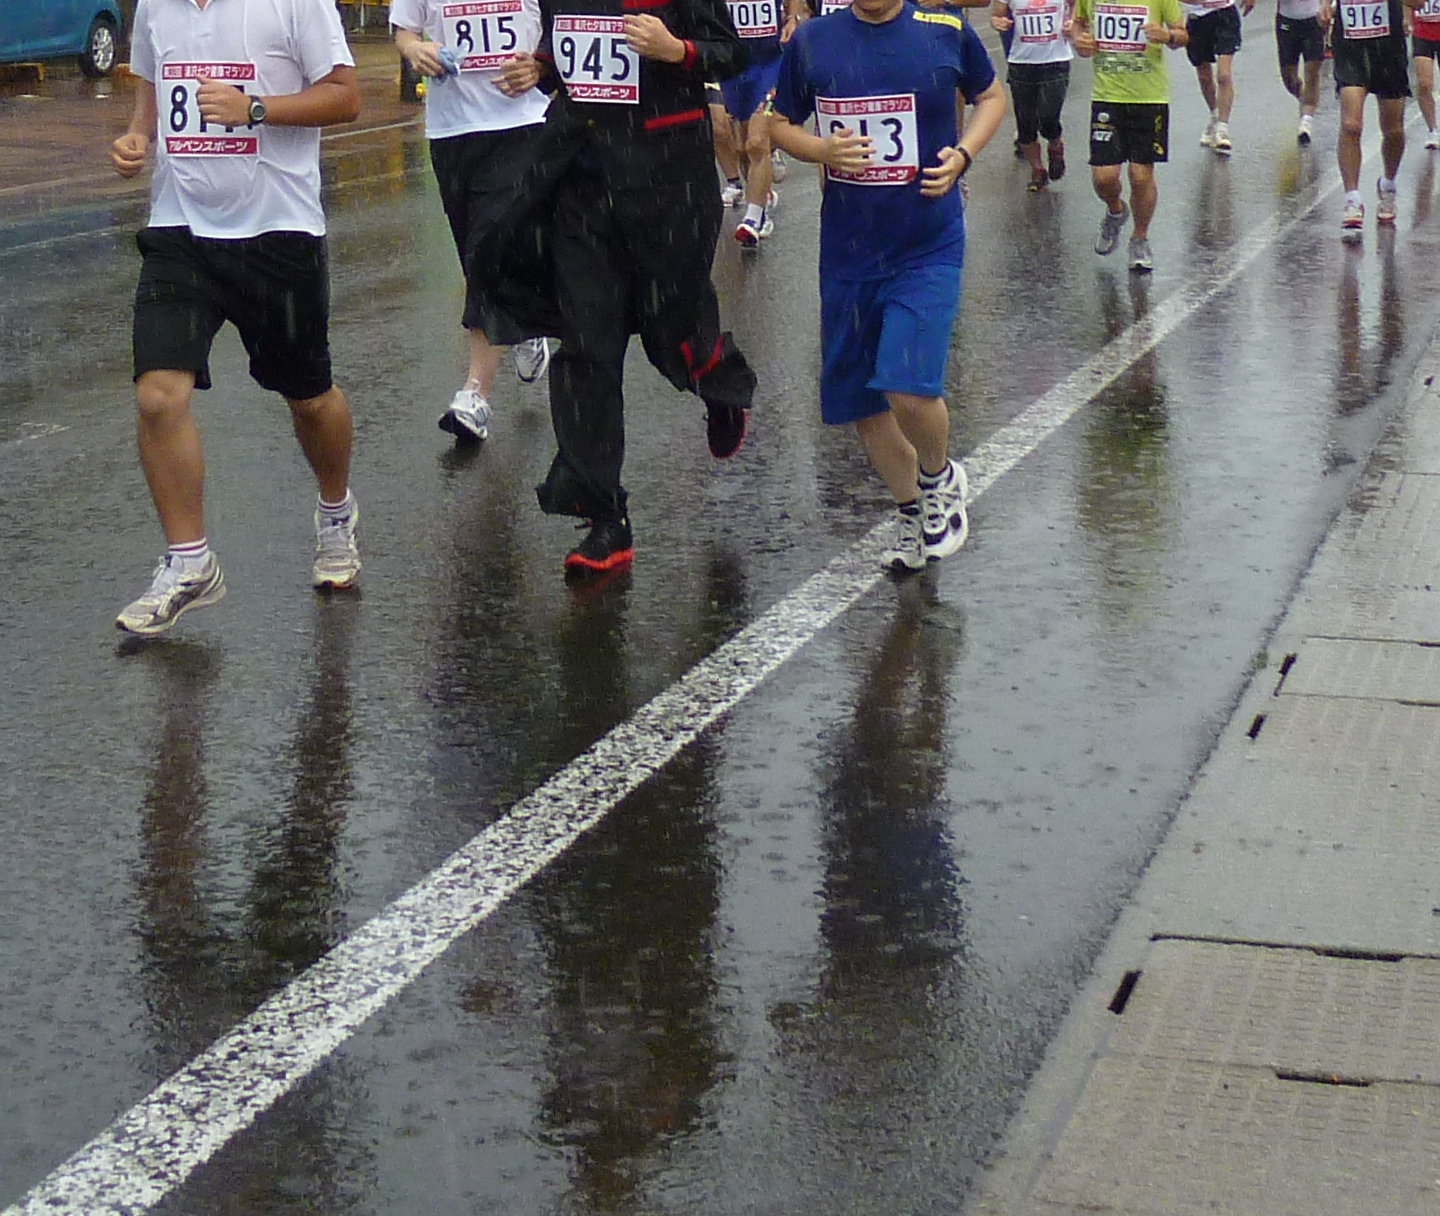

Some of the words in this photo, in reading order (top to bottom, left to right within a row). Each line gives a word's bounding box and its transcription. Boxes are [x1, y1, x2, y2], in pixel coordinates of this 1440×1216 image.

[730, 2, 772, 26] 1019
[1022, 15, 1054, 35] 1113
[1347, 5, 1383, 28] 916
[455, 15, 517, 53] 815
[1098, 15, 1145, 41] 1097
[560, 36, 630, 81] 945
[566, 85, 630, 98] ペンスポーツ
[168, 139, 249, 152] アルペンスポーツ
